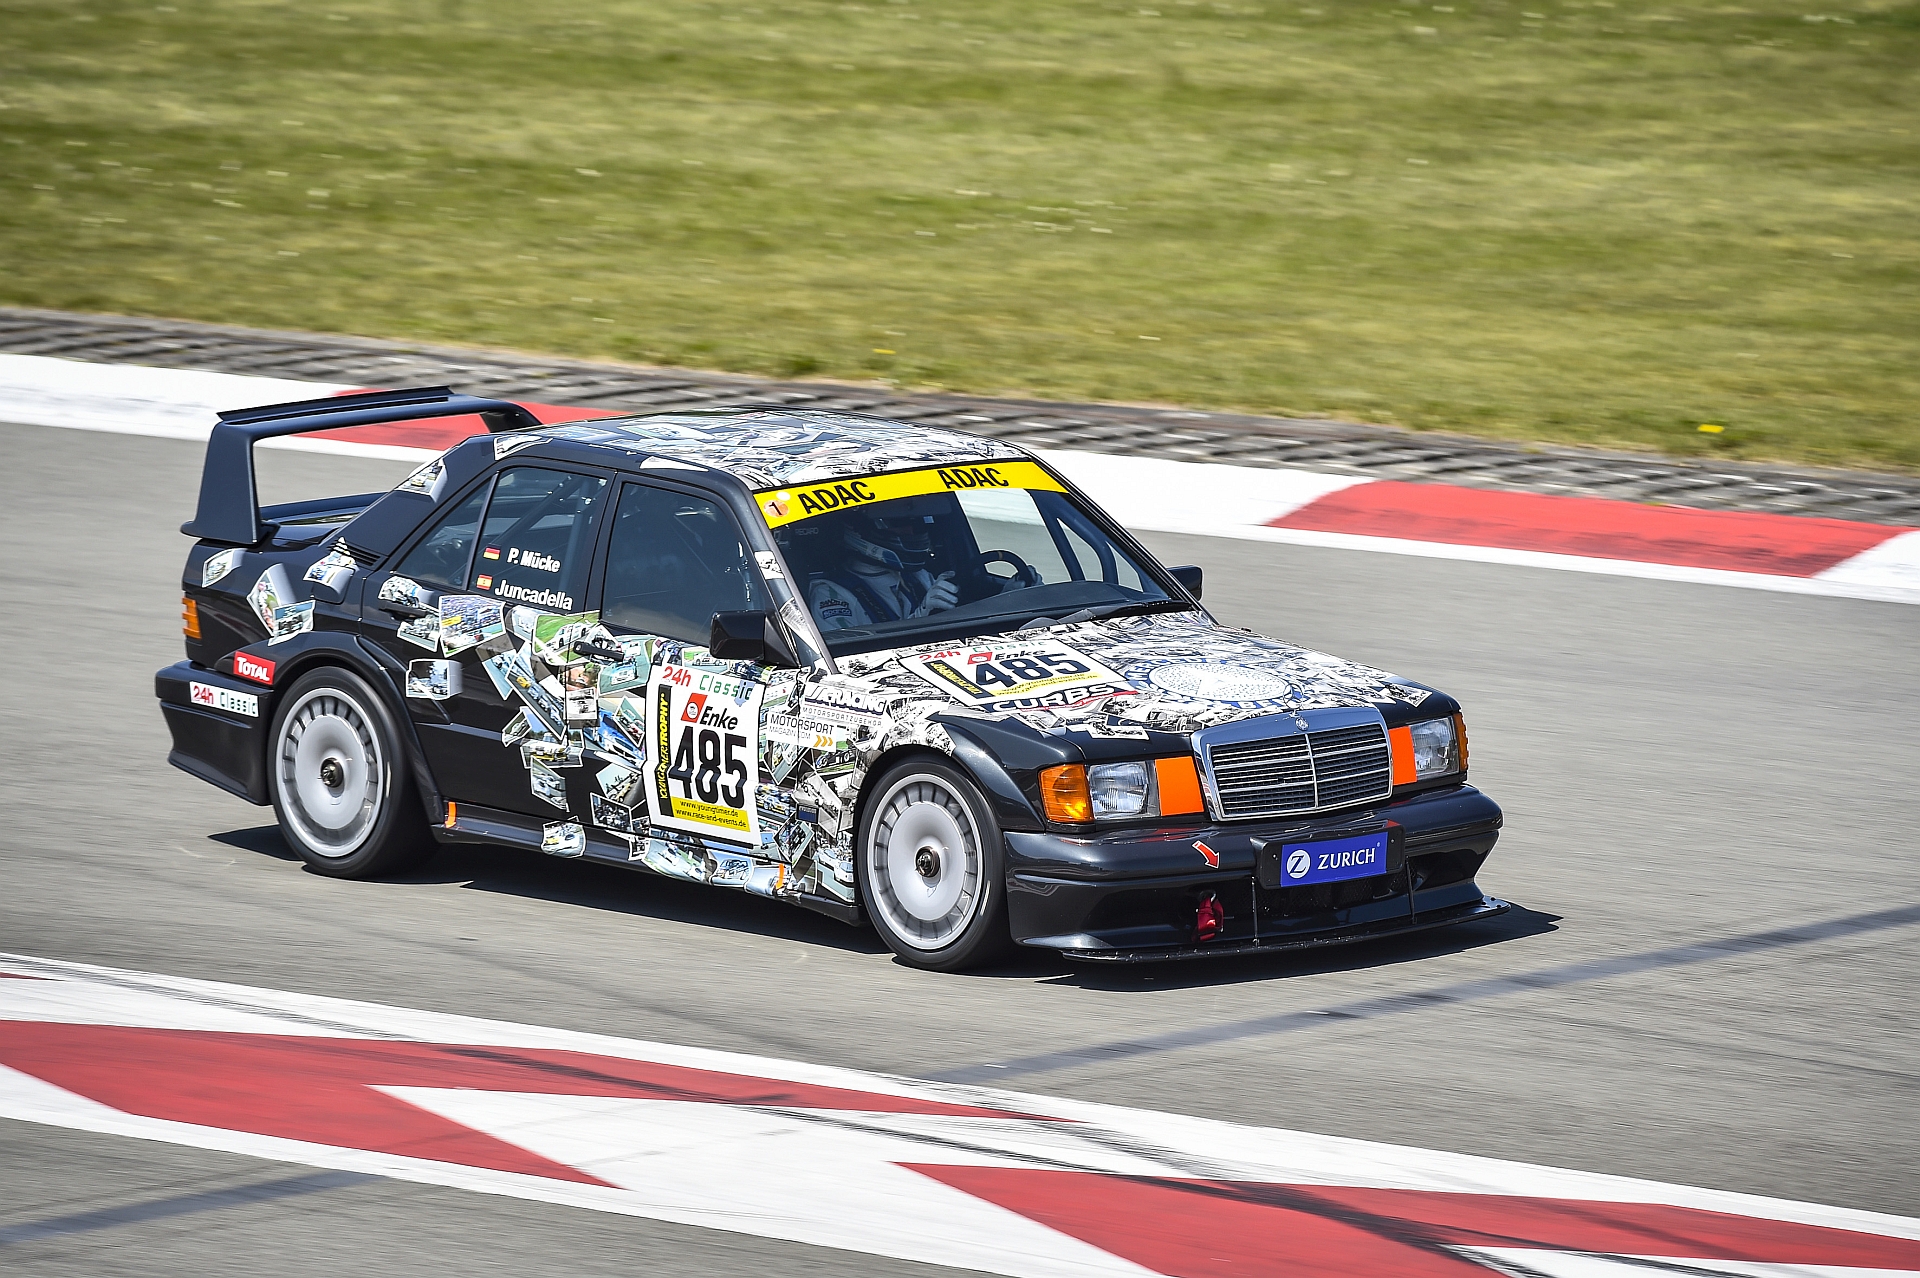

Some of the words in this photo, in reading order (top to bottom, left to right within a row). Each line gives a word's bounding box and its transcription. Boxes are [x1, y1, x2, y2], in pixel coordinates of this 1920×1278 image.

[937, 467, 1009, 489] ADAC
[768, 501, 783, 516] 1
[798, 481, 876, 514] ADAC
[507, 547, 518, 564] P.
[520, 550, 561, 573] Mücke
[494, 579, 573, 611] Juncadella
[919, 650, 961, 662] 24h
[973, 641, 1047, 653] Classic
[994, 650, 1046, 660] Enke
[237, 656, 270, 681] TOTAL
[976, 653, 1091, 687] 485
[662, 665, 691, 687] 24h
[699, 674, 754, 701] Classic
[193, 685, 214, 704] 24h
[220, 691, 256, 714] Classic
[992, 684, 1115, 710] CURBS
[699, 705, 738, 730] Enke
[770, 713, 834, 735] MOTORSPORT
[668, 725, 747, 809] 485
[1317, 847, 1376, 870] ZURICH
